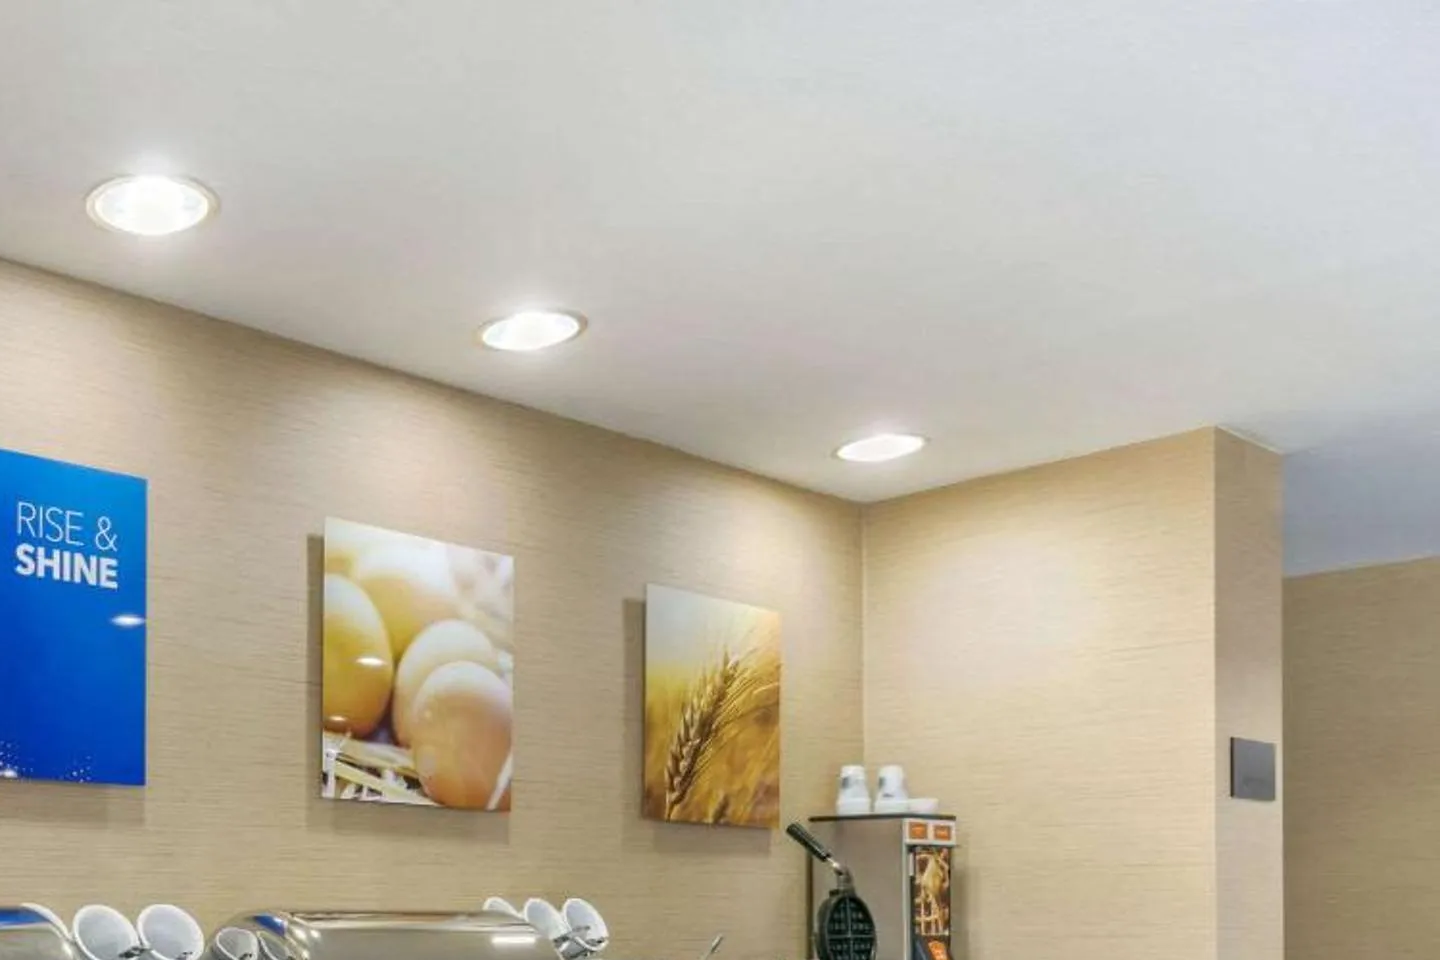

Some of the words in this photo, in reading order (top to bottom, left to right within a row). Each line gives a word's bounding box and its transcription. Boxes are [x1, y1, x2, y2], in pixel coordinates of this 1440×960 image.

[16, 501, 84, 546] RISE
[95, 515, 118, 552] &
[15, 543, 118, 589] SHINE
